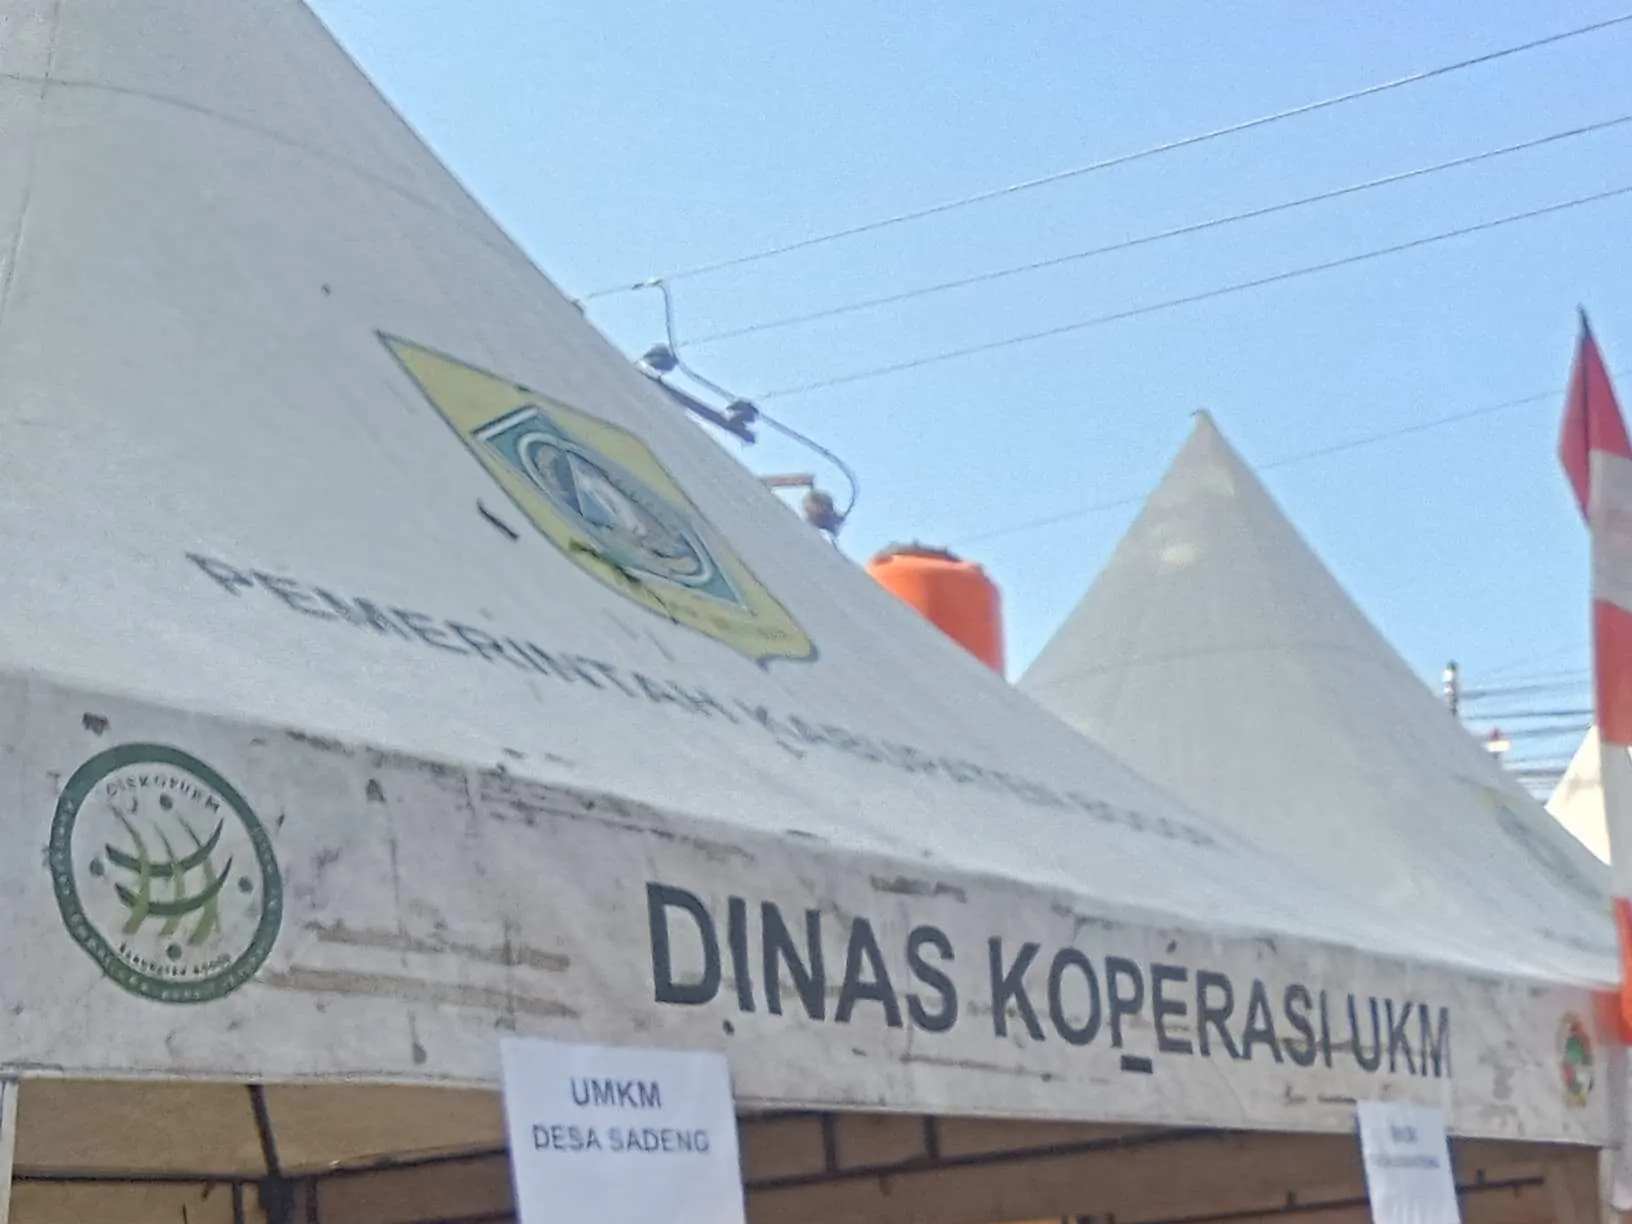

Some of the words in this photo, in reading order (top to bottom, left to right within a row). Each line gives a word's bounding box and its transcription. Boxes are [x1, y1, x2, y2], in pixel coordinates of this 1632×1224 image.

[187, 552, 740, 724] PEMERINTAH
[645, 881, 958, 1033] DINAS
[987, 935, 1332, 1069] KOPERASI
[1347, 992, 1453, 1079] UKM
[532, 1123, 602, 1152] DESA
[608, 1127, 711, 1154] SADENG
[569, 1076, 662, 1109] UMKM
